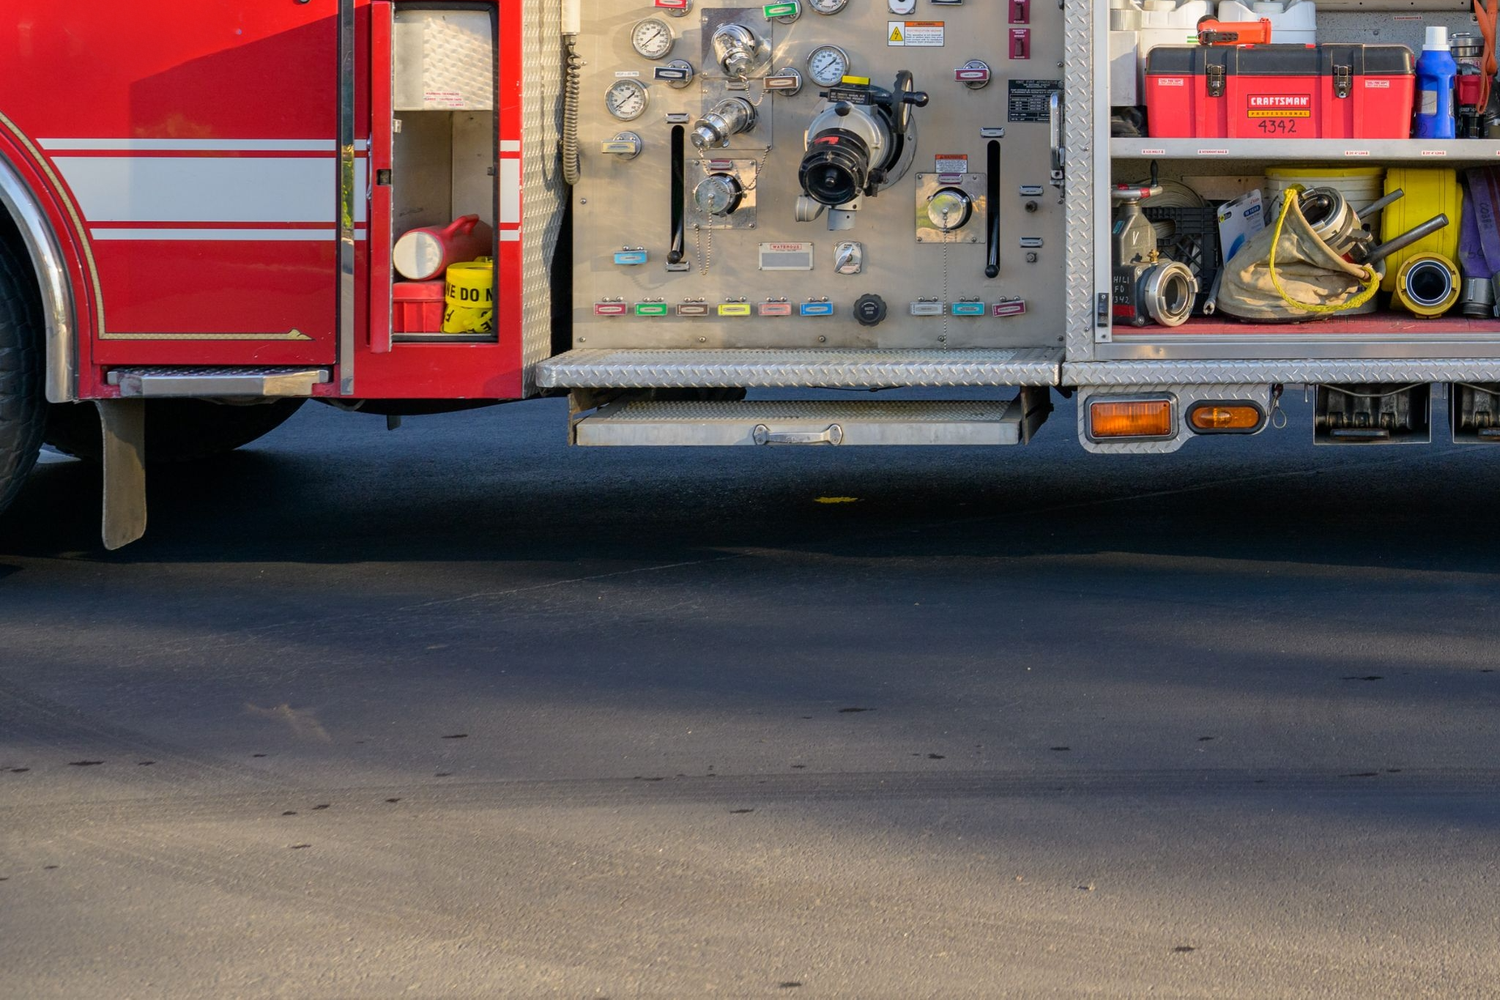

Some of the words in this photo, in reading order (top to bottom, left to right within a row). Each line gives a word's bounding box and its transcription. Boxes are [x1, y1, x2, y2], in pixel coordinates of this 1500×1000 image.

[1250, 96, 1307, 106] CRAFTSMAN
[1258, 119, 1297, 133] 4342
[1112, 276, 1130, 284] HILI
[460, 288, 479, 302] DO
[1112, 296, 1130, 304] 342
